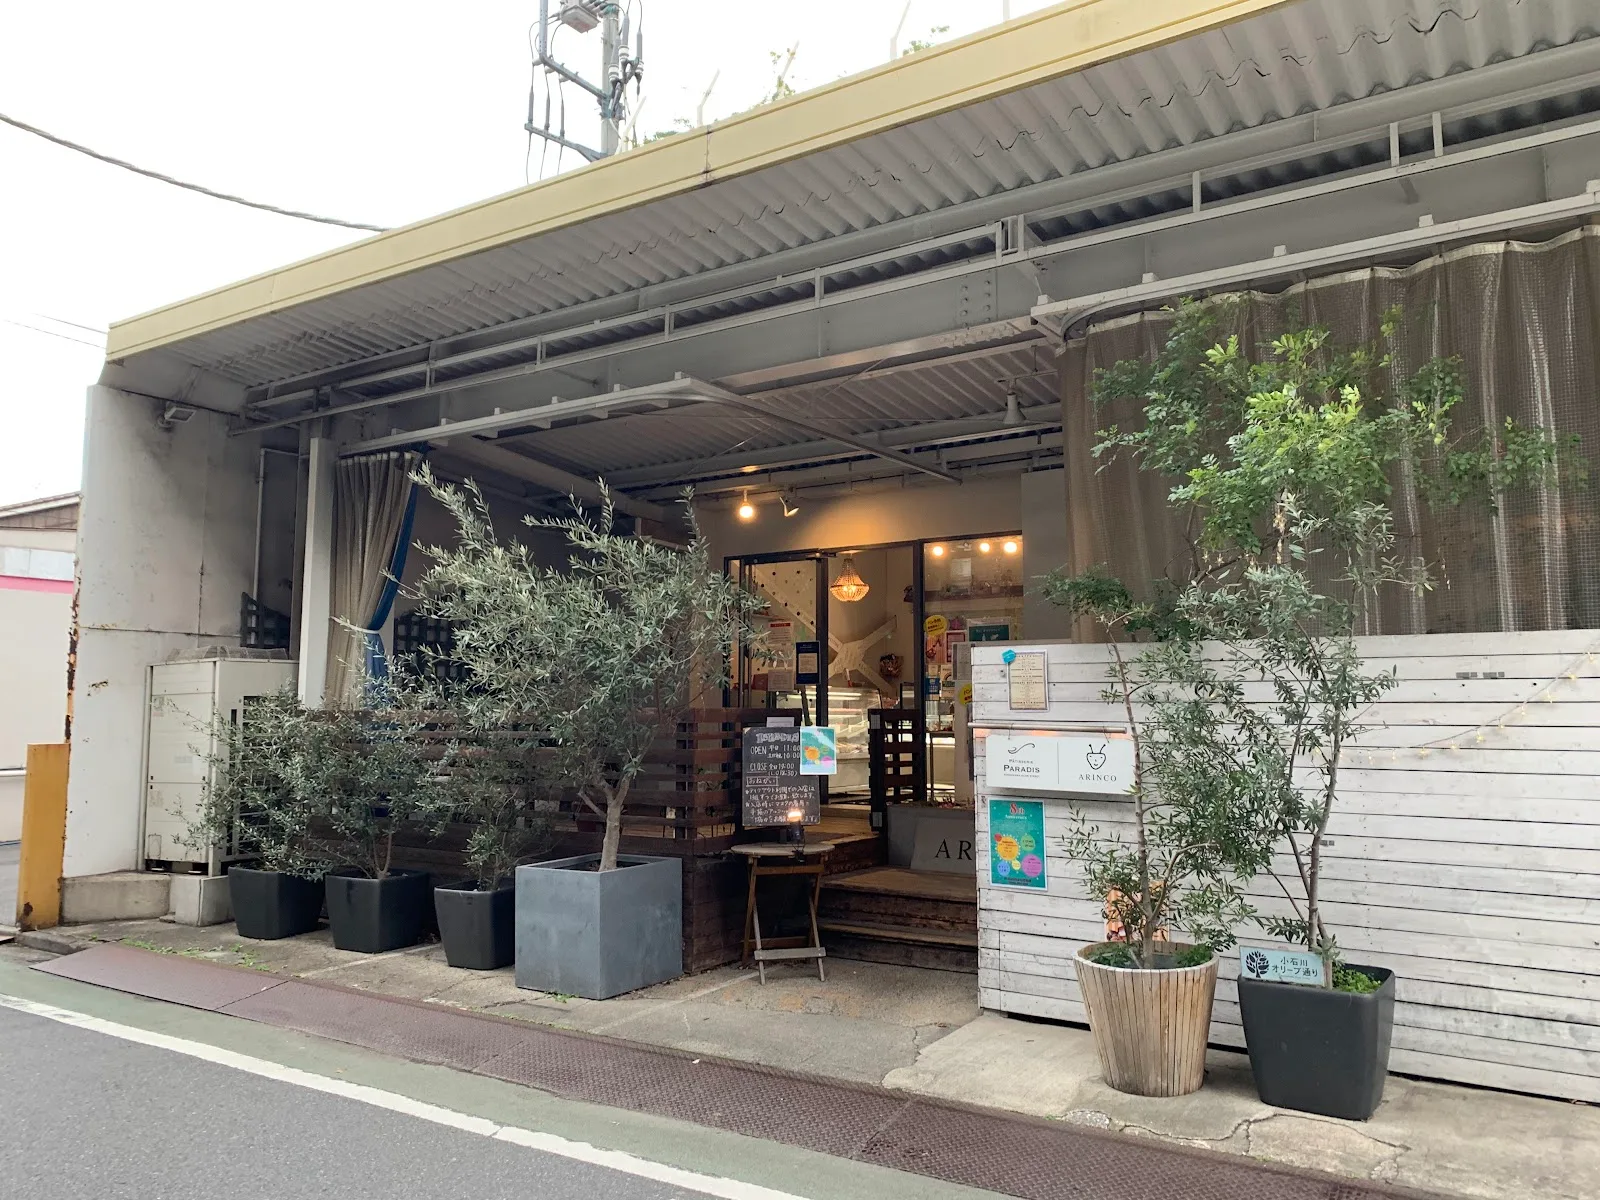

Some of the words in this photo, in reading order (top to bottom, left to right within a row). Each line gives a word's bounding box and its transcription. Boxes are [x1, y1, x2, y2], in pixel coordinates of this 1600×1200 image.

[750, 746, 767, 755] OPEN
[749, 763, 768, 772] CLOSE
[1003, 764, 1041, 774] PARADIS
[1078, 774, 1117, 783] ARINCO
[1280, 956, 1308, 966] 小石川
